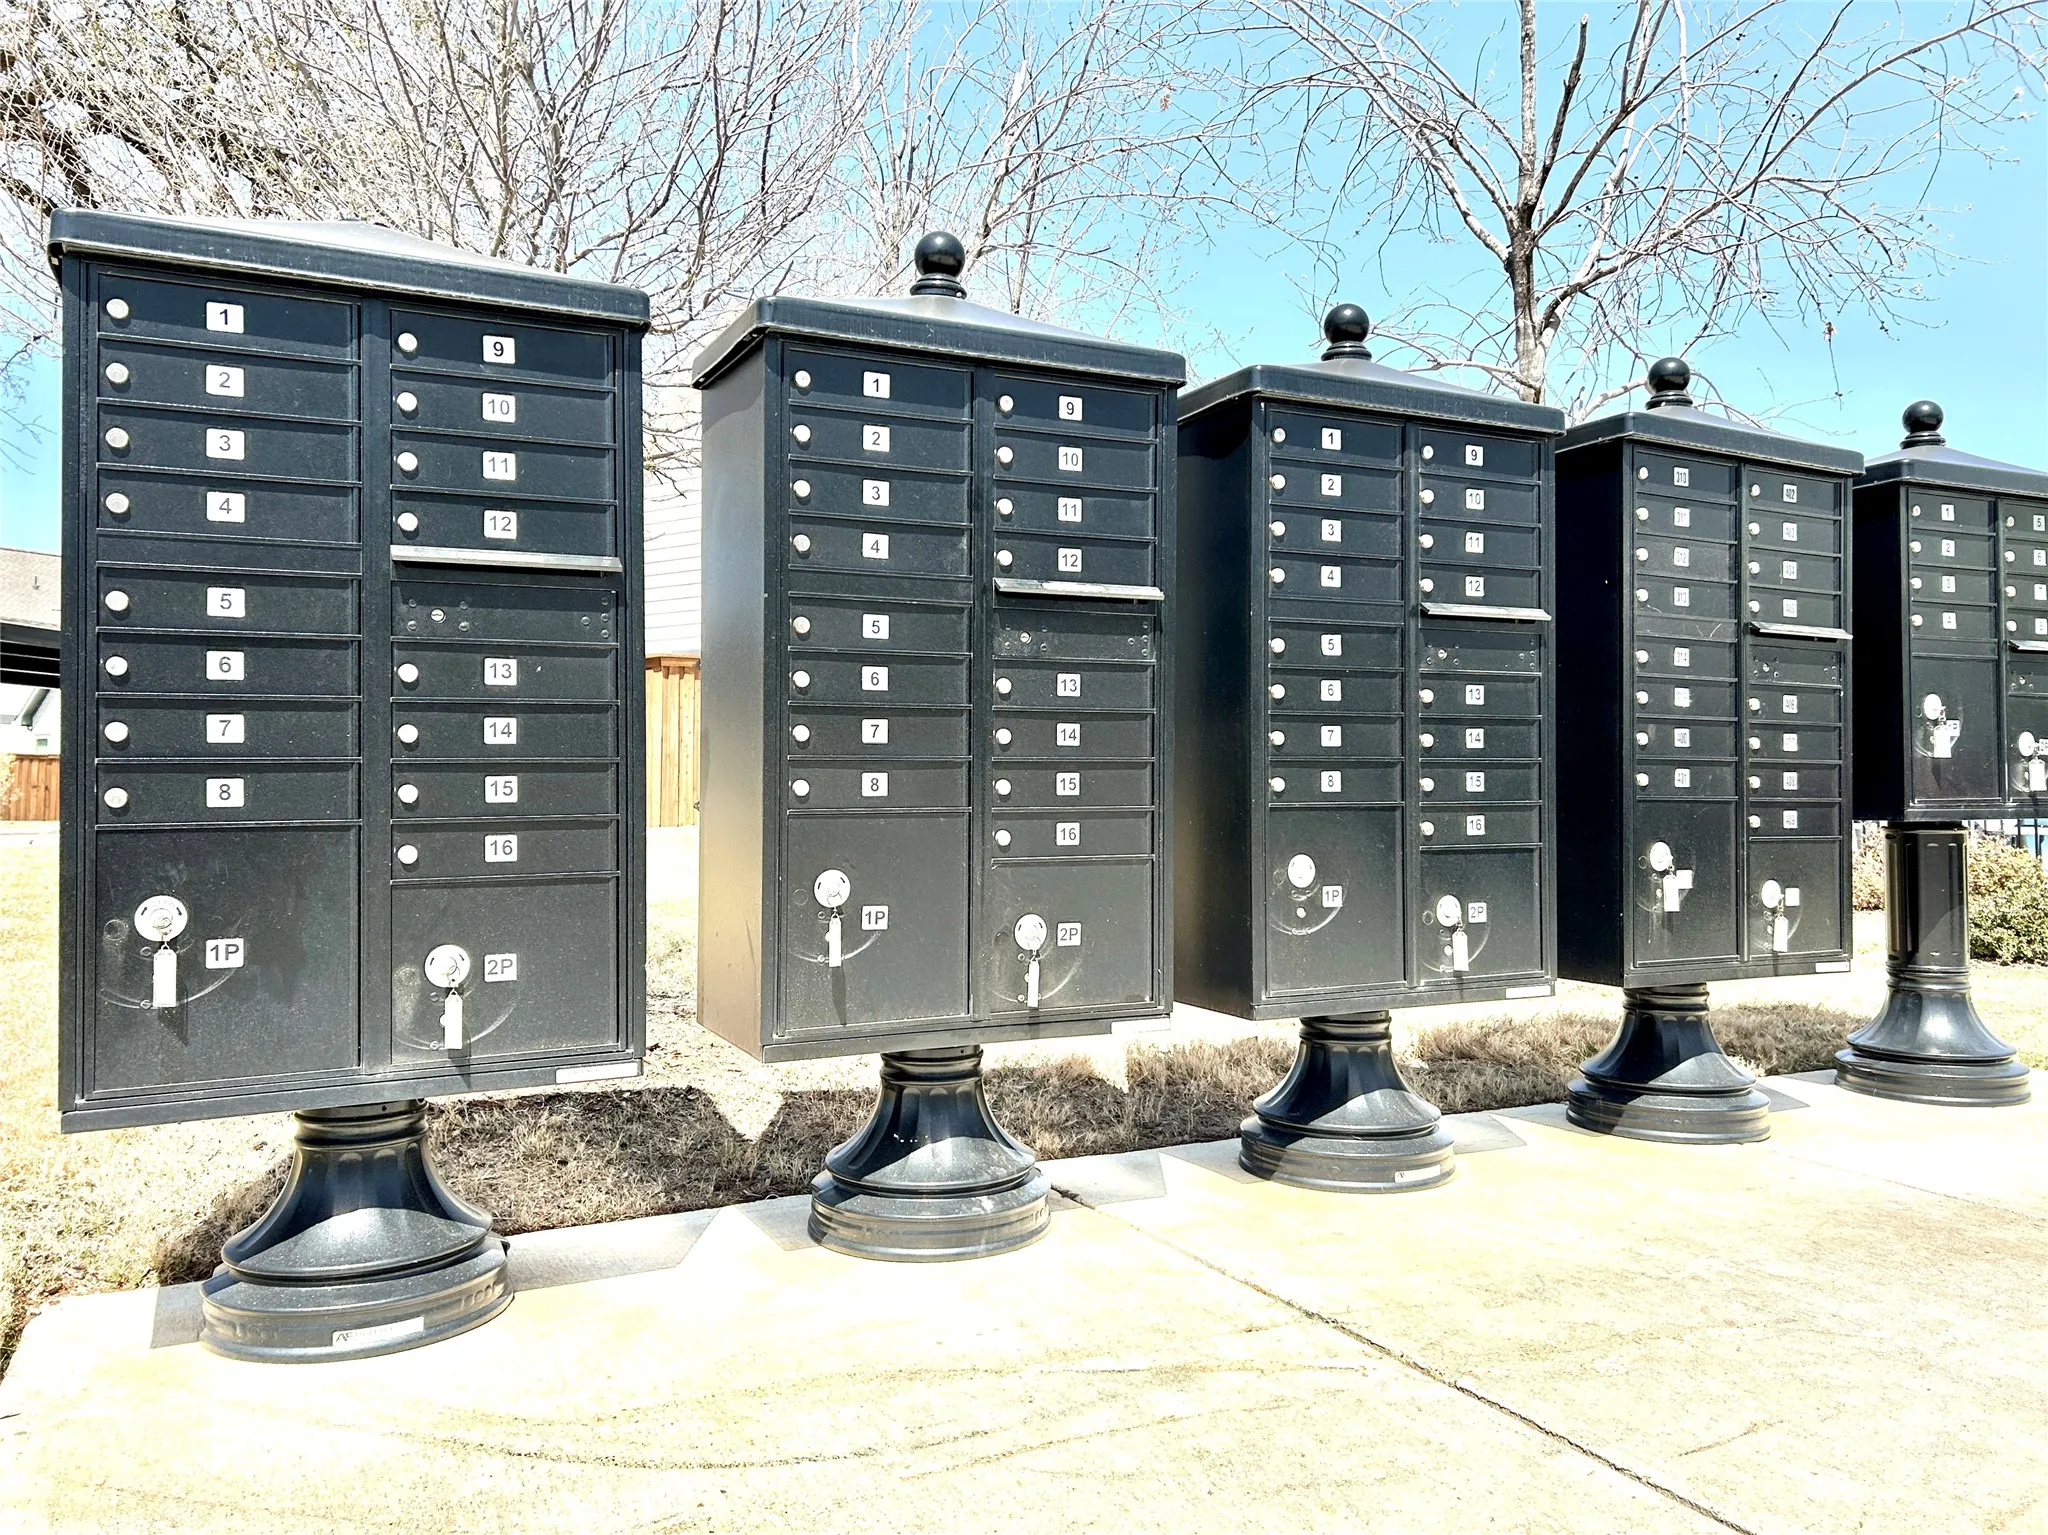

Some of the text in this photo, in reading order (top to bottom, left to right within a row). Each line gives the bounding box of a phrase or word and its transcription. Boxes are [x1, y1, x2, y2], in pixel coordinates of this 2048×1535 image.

[219, 308, 229, 326] 1
[492, 341, 505, 358] 9
[218, 371, 231, 389] 2
[872, 377, 879, 393] 1
[487, 398, 510, 416] 10
[1066, 401, 1075, 416] 9
[218, 434, 231, 452] 3
[871, 431, 881, 446] 2
[1062, 452, 1079, 467] 10
[1470, 448, 1478, 462] 9
[487, 456, 508, 474] 11
[1327, 478, 1335, 491] 2
[1676, 471, 1687, 484] 310
[871, 485, 881, 501] 3
[1468, 492, 1481, 505] 10
[1785, 488, 1796, 500] 402
[218, 497, 232, 515] 4
[1062, 502, 1077, 517] 11
[489, 515, 512, 532] 12
[1327, 523, 1335, 537] 3
[870, 539, 881, 554] 4
[1468, 536, 1480, 548] 11
[1061, 553, 1079, 568] 12
[1327, 569, 1335, 581] 4
[1468, 579, 1481, 592] 12
[219, 593, 233, 610] 5
[871, 619, 881, 635] 5
[1327, 638, 1335, 651] 5
[218, 656, 232, 674] 6
[489, 662, 512, 679] 13
[870, 671, 880, 687] 6
[1060, 678, 1078, 693] 13
[1327, 683, 1335, 697] 6
[1468, 688, 1481, 701] 13
[218, 719, 232, 737] 7
[489, 721, 513, 738] 14
[870, 724, 880, 739] 7
[1060, 728, 1077, 742] 14
[1327, 729, 1335, 741] 7
[1468, 732, 1482, 744] 14
[490, 780, 514, 797] 15
[870, 777, 880, 792] 8
[1059, 777, 1077, 791] 15
[1327, 774, 1335, 788] 8
[1469, 775, 1482, 788] 15
[218, 783, 232, 801] 8
[1469, 818, 1482, 831] 16
[1060, 827, 1077, 841] 16
[490, 839, 513, 856] 16
[1324, 889, 1340, 902] 1P
[864, 910, 886, 925] 1P
[1470, 905, 1484, 919] 2P
[1059, 927, 1079, 941] 2P
[210, 943, 240, 962] 1P
[487, 958, 514, 976] 2P
